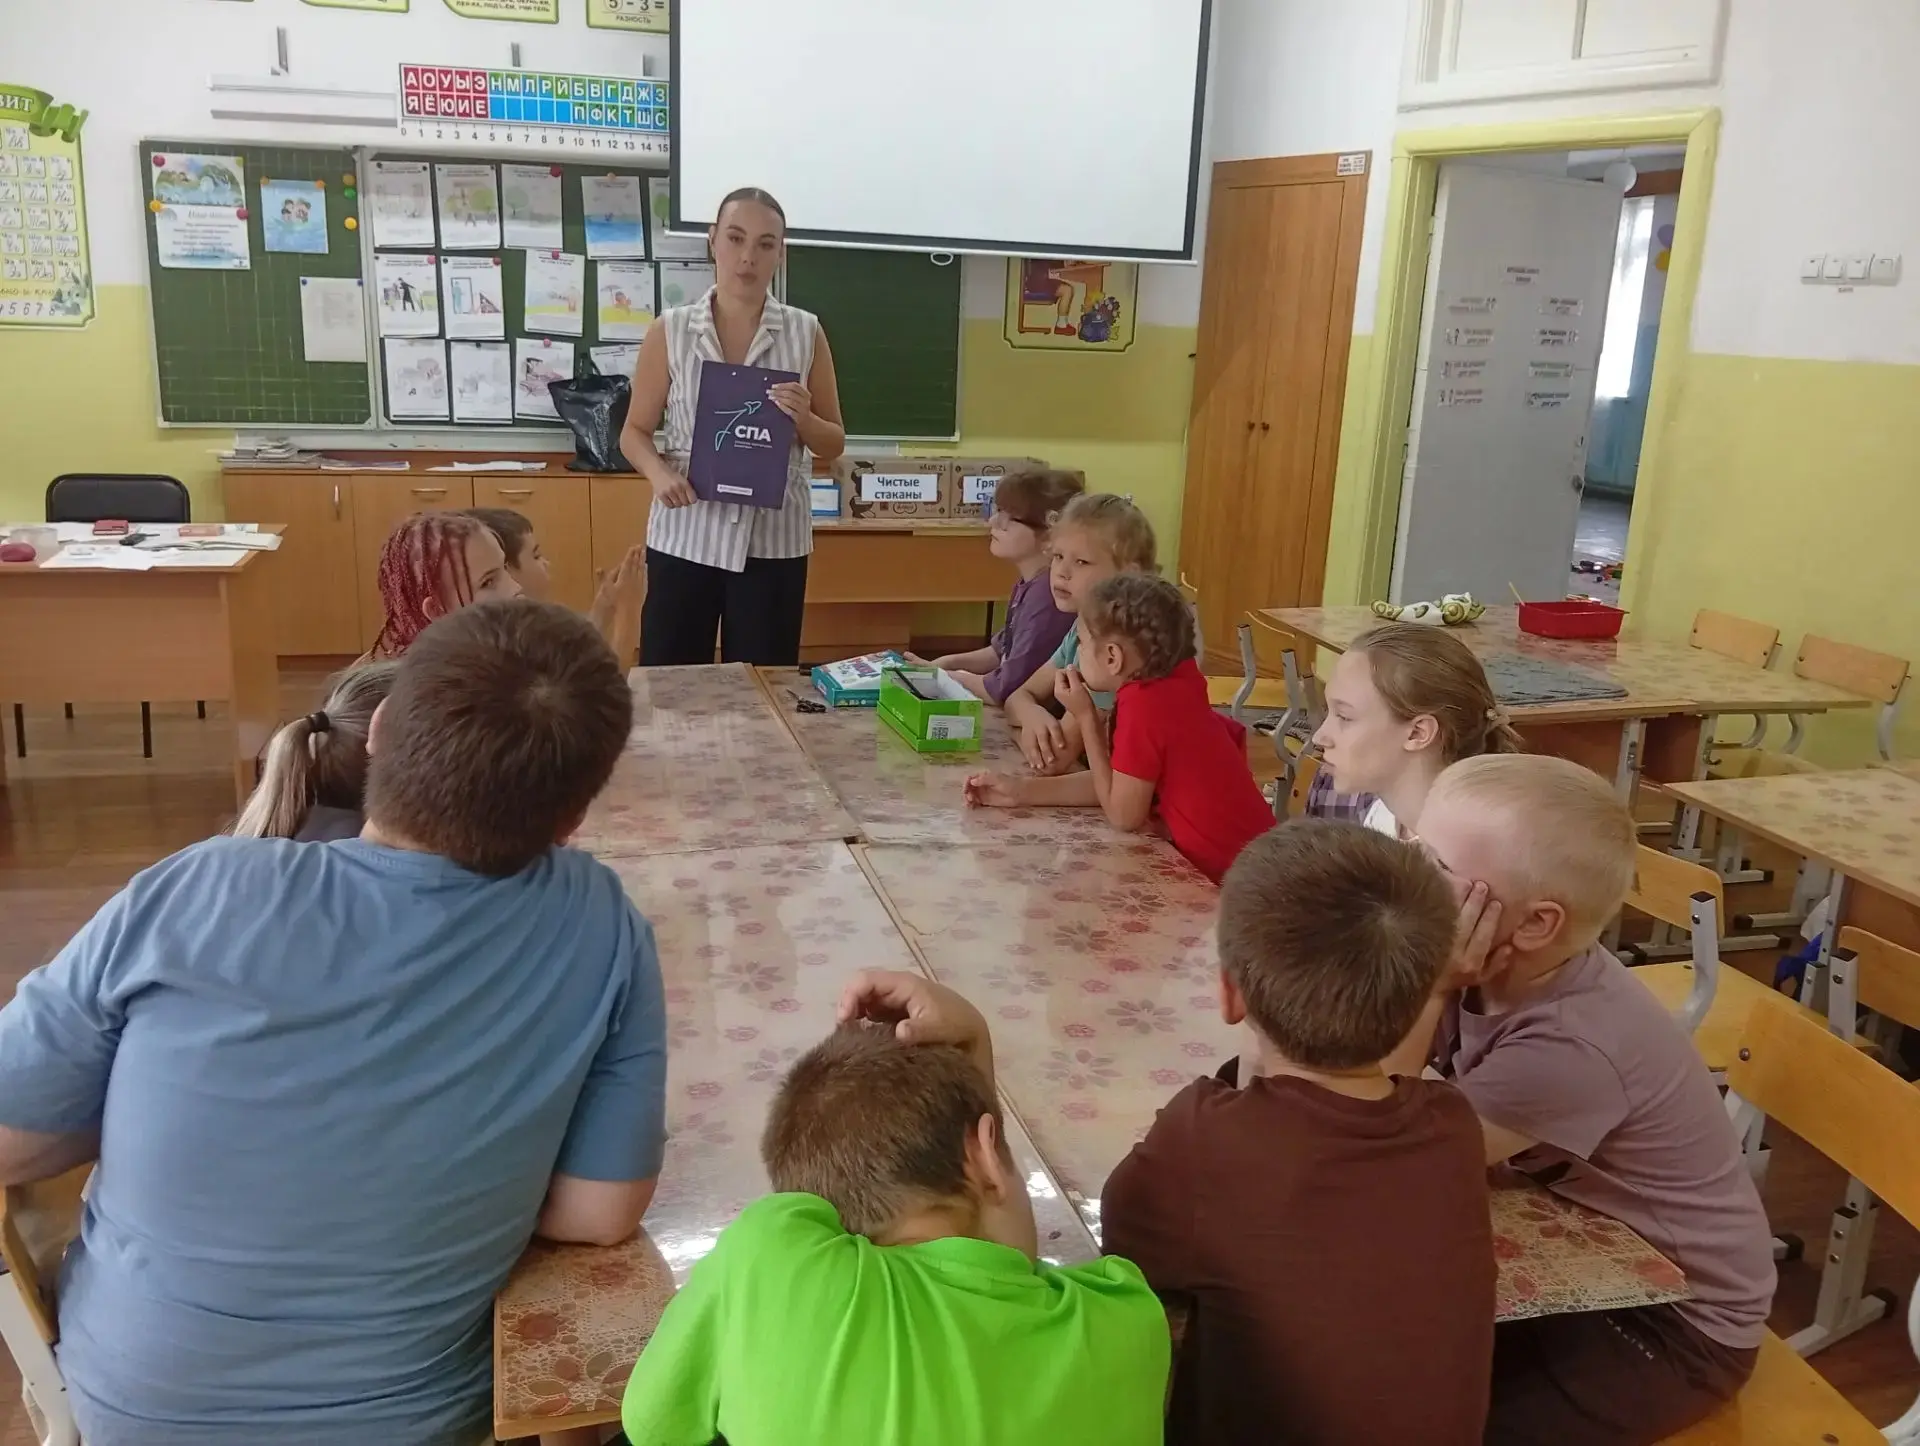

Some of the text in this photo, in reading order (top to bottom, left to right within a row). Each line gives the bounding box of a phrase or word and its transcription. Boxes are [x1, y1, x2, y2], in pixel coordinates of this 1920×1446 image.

[615, 14, 651, 24] РАЗНОСТЬ
[401, 127, 668, 153] 0 1 2 3 4 5 6 7 8 9 10 11 12 13 14 15
[734, 425, 771, 442] СПА
[877, 477, 920, 487] Чистые
[874, 491, 922, 500] стаканы
